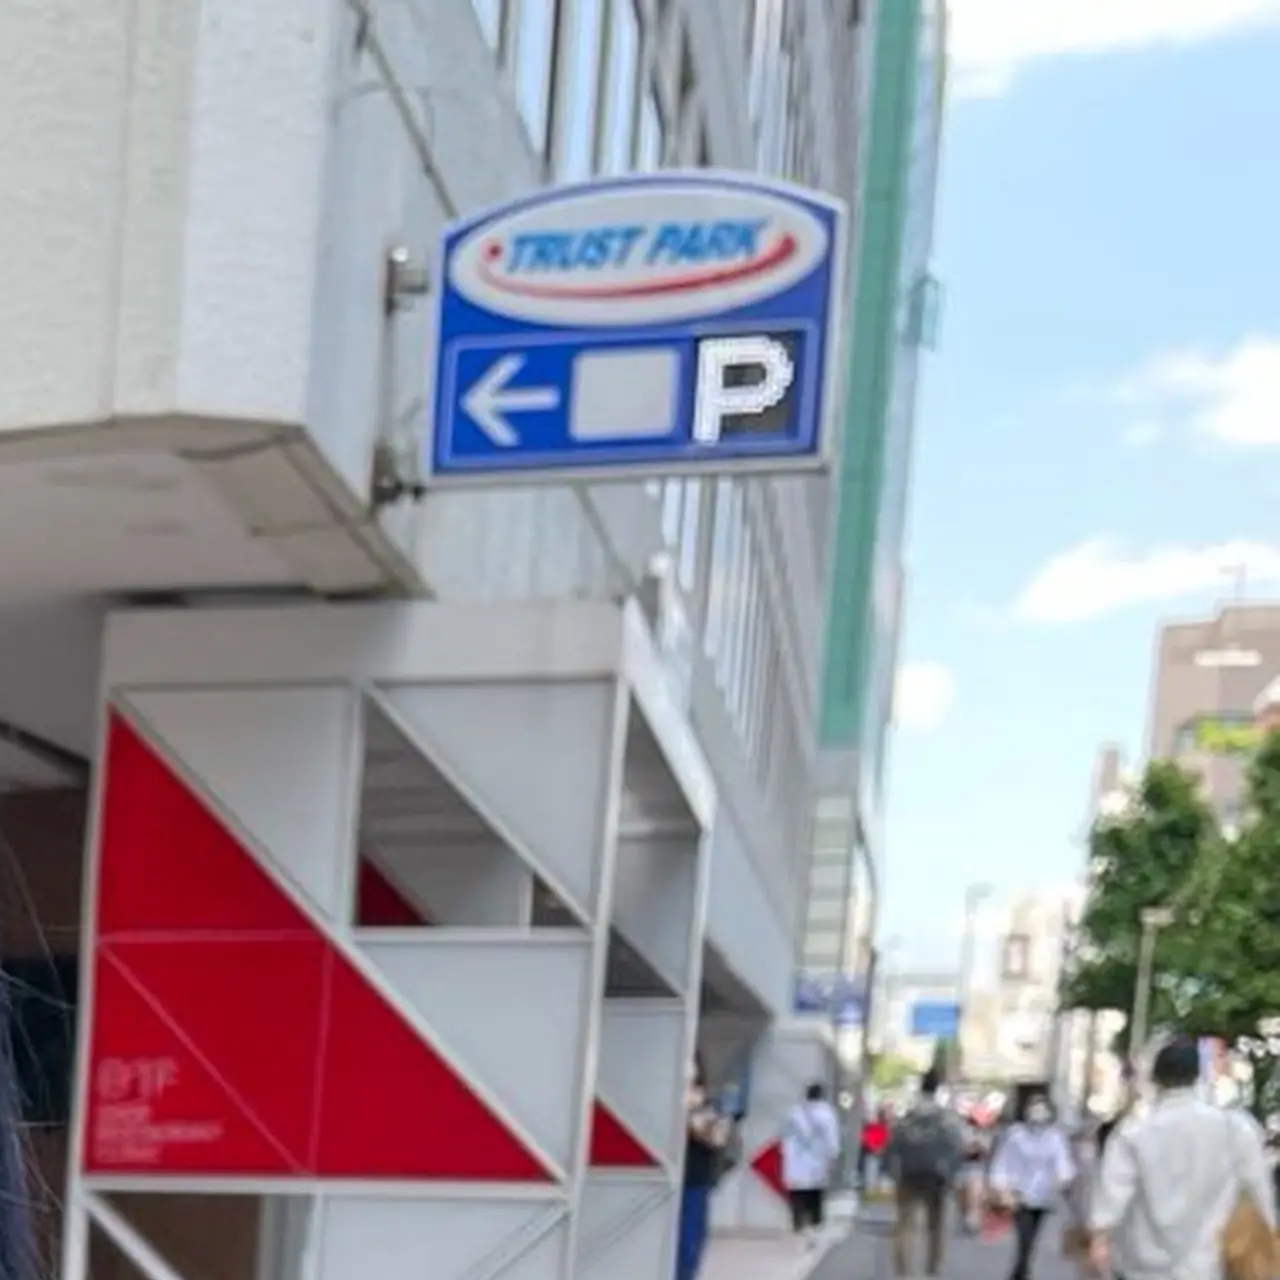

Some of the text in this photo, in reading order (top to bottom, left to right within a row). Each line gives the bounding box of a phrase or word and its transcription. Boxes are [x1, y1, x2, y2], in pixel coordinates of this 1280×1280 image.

[507, 217, 770, 273] TRUST PARK
[693, 334, 794, 446] P
